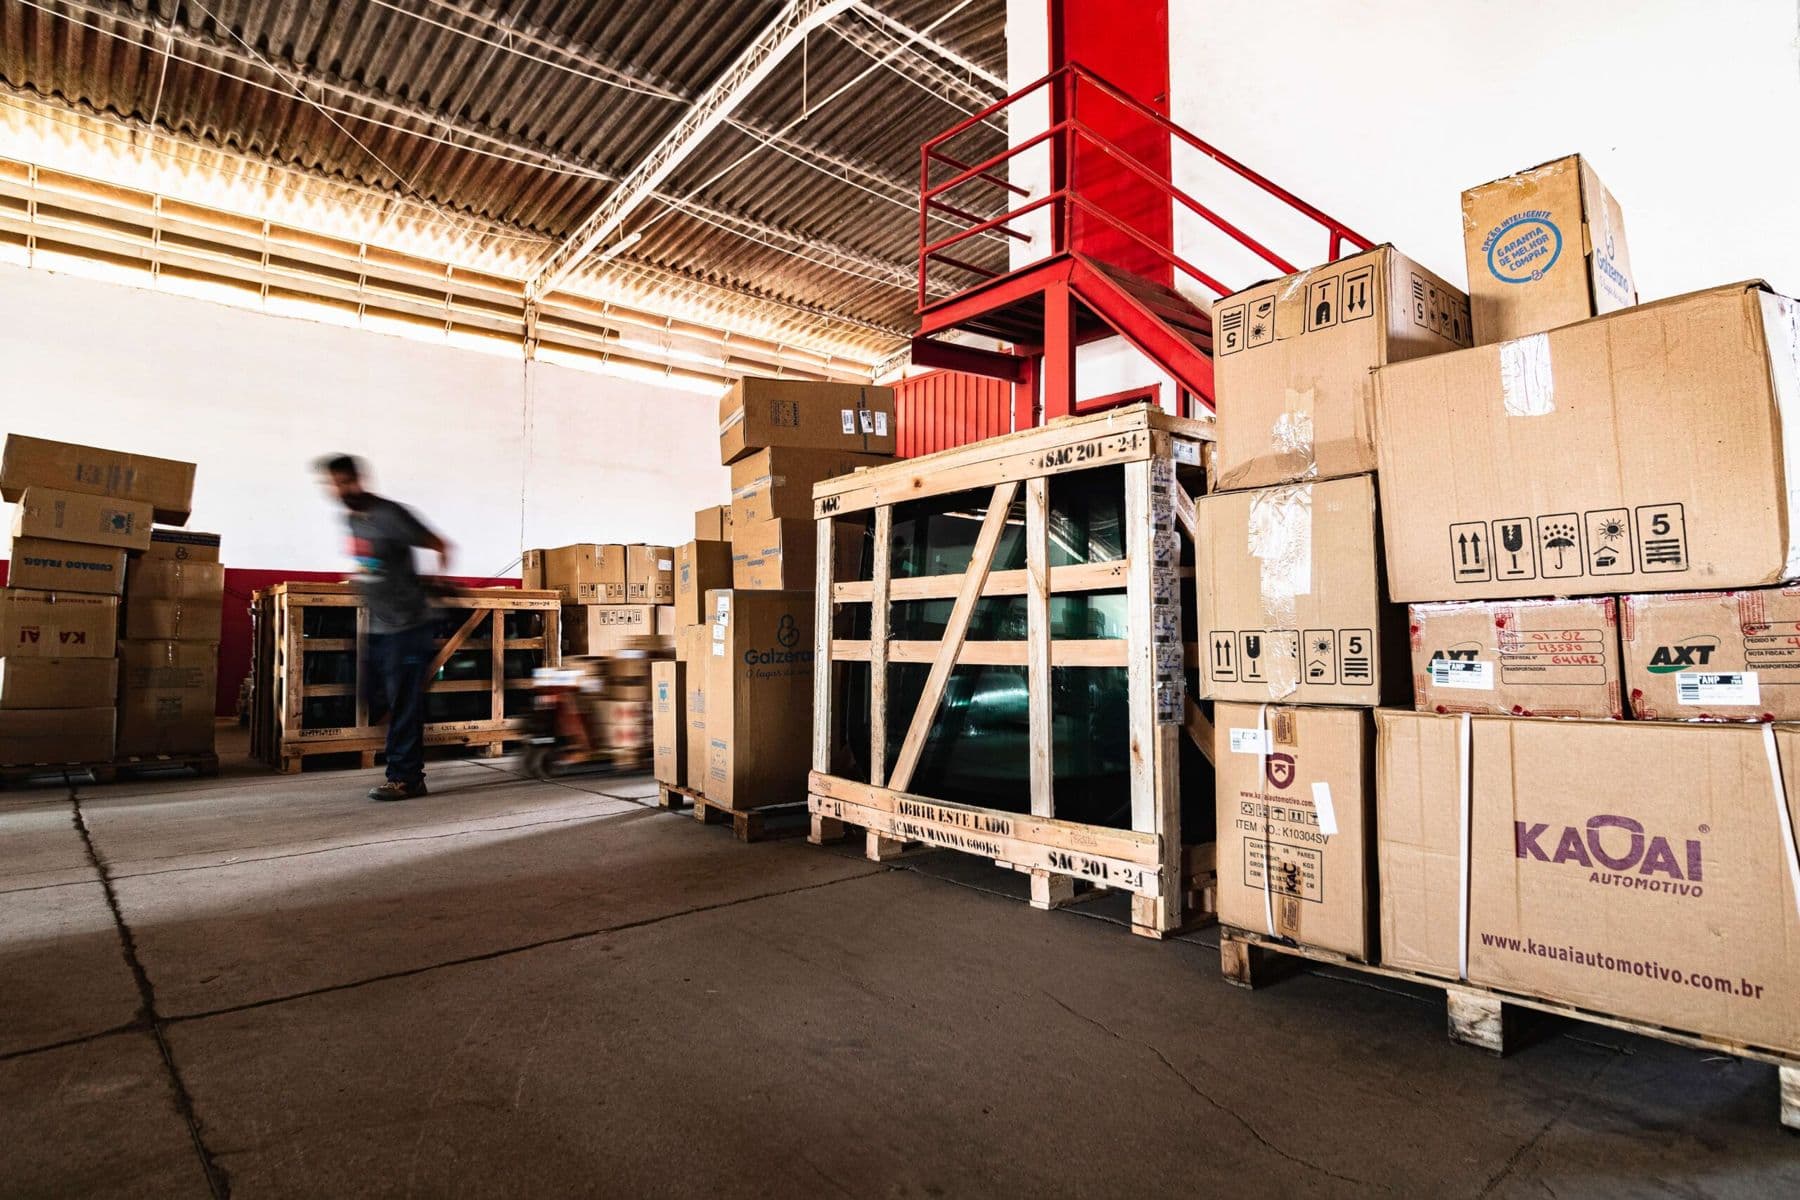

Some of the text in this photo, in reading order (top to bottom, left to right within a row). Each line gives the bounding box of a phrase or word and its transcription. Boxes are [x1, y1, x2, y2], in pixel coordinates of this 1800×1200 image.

[1501, 210, 1552, 229] INTELIGENTE
[1497, 227, 1543, 257] GARANTIA
[1499, 234, 1549, 267] DE MELHOR
[1509, 246, 1548, 271] COMPRA
[1045, 446, 1073, 468] SAC
[1077, 442, 1103, 460] 201
[1652, 513, 1670, 536] 5
[1349, 636, 1362, 654] 5
[1650, 645, 1715, 665] AXT
[896, 821, 925, 838] CARGA
[898, 801, 1010, 835] ABRIR ESTE LADO
[1236, 818, 1257, 832] ITEM
[1282, 827, 1329, 845] K10304SV
[1049, 851, 1077, 870] SAC
[1081, 857, 1108, 879] 201
[1589, 872, 1703, 898] AUTOMOTIVO
[1481, 932, 1764, 1000] www.kauaiautomotivo.com.br
